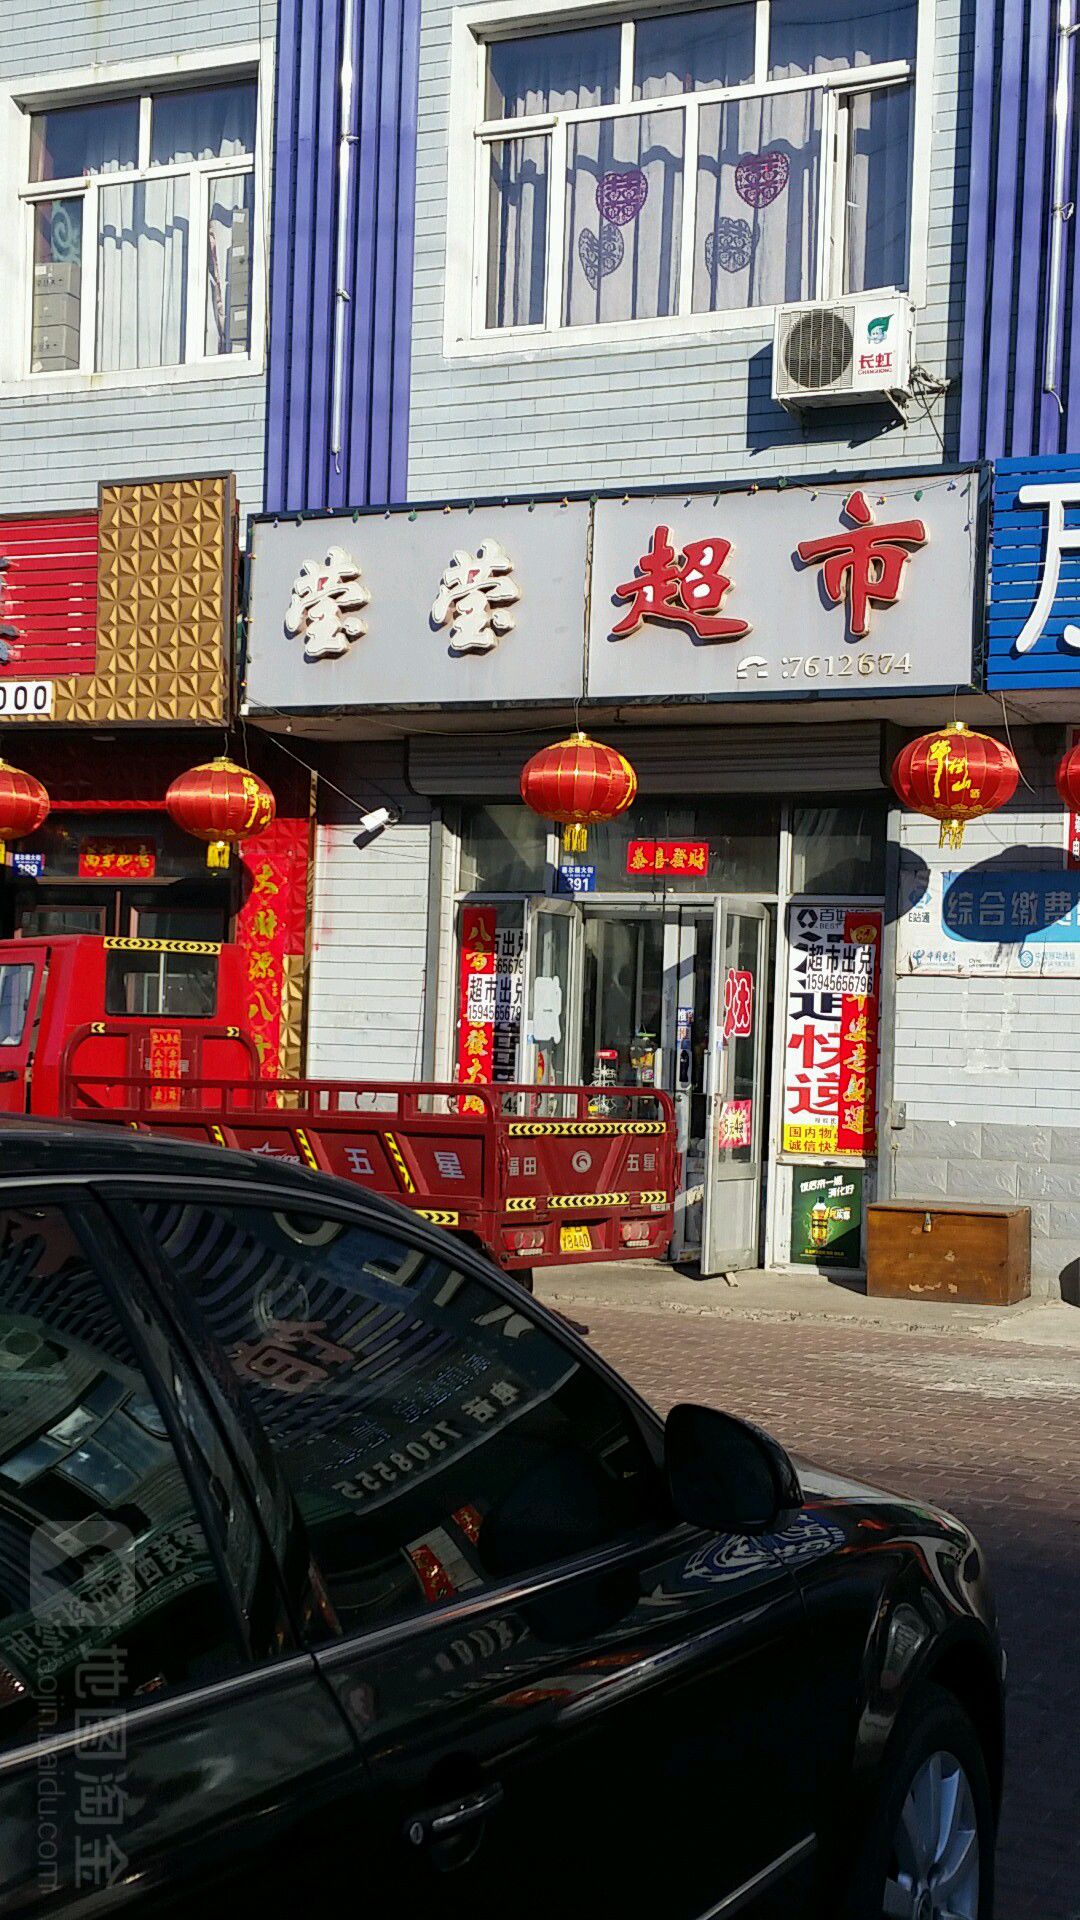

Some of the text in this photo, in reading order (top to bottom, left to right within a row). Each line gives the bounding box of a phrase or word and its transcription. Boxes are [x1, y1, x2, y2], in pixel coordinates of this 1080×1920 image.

[859, 352, 893, 369] 长虹
[566, 877, 590, 891] 391
[948, 890, 1080, 927] 综合缴费
[820, 922, 842, 930] BEST
[807, 943, 873, 975] 超市出兑
[807, 974, 873, 993] 15945656796
[789, 1126, 838, 1138] 国内物
[627, 1153, 655, 1172] 五星
